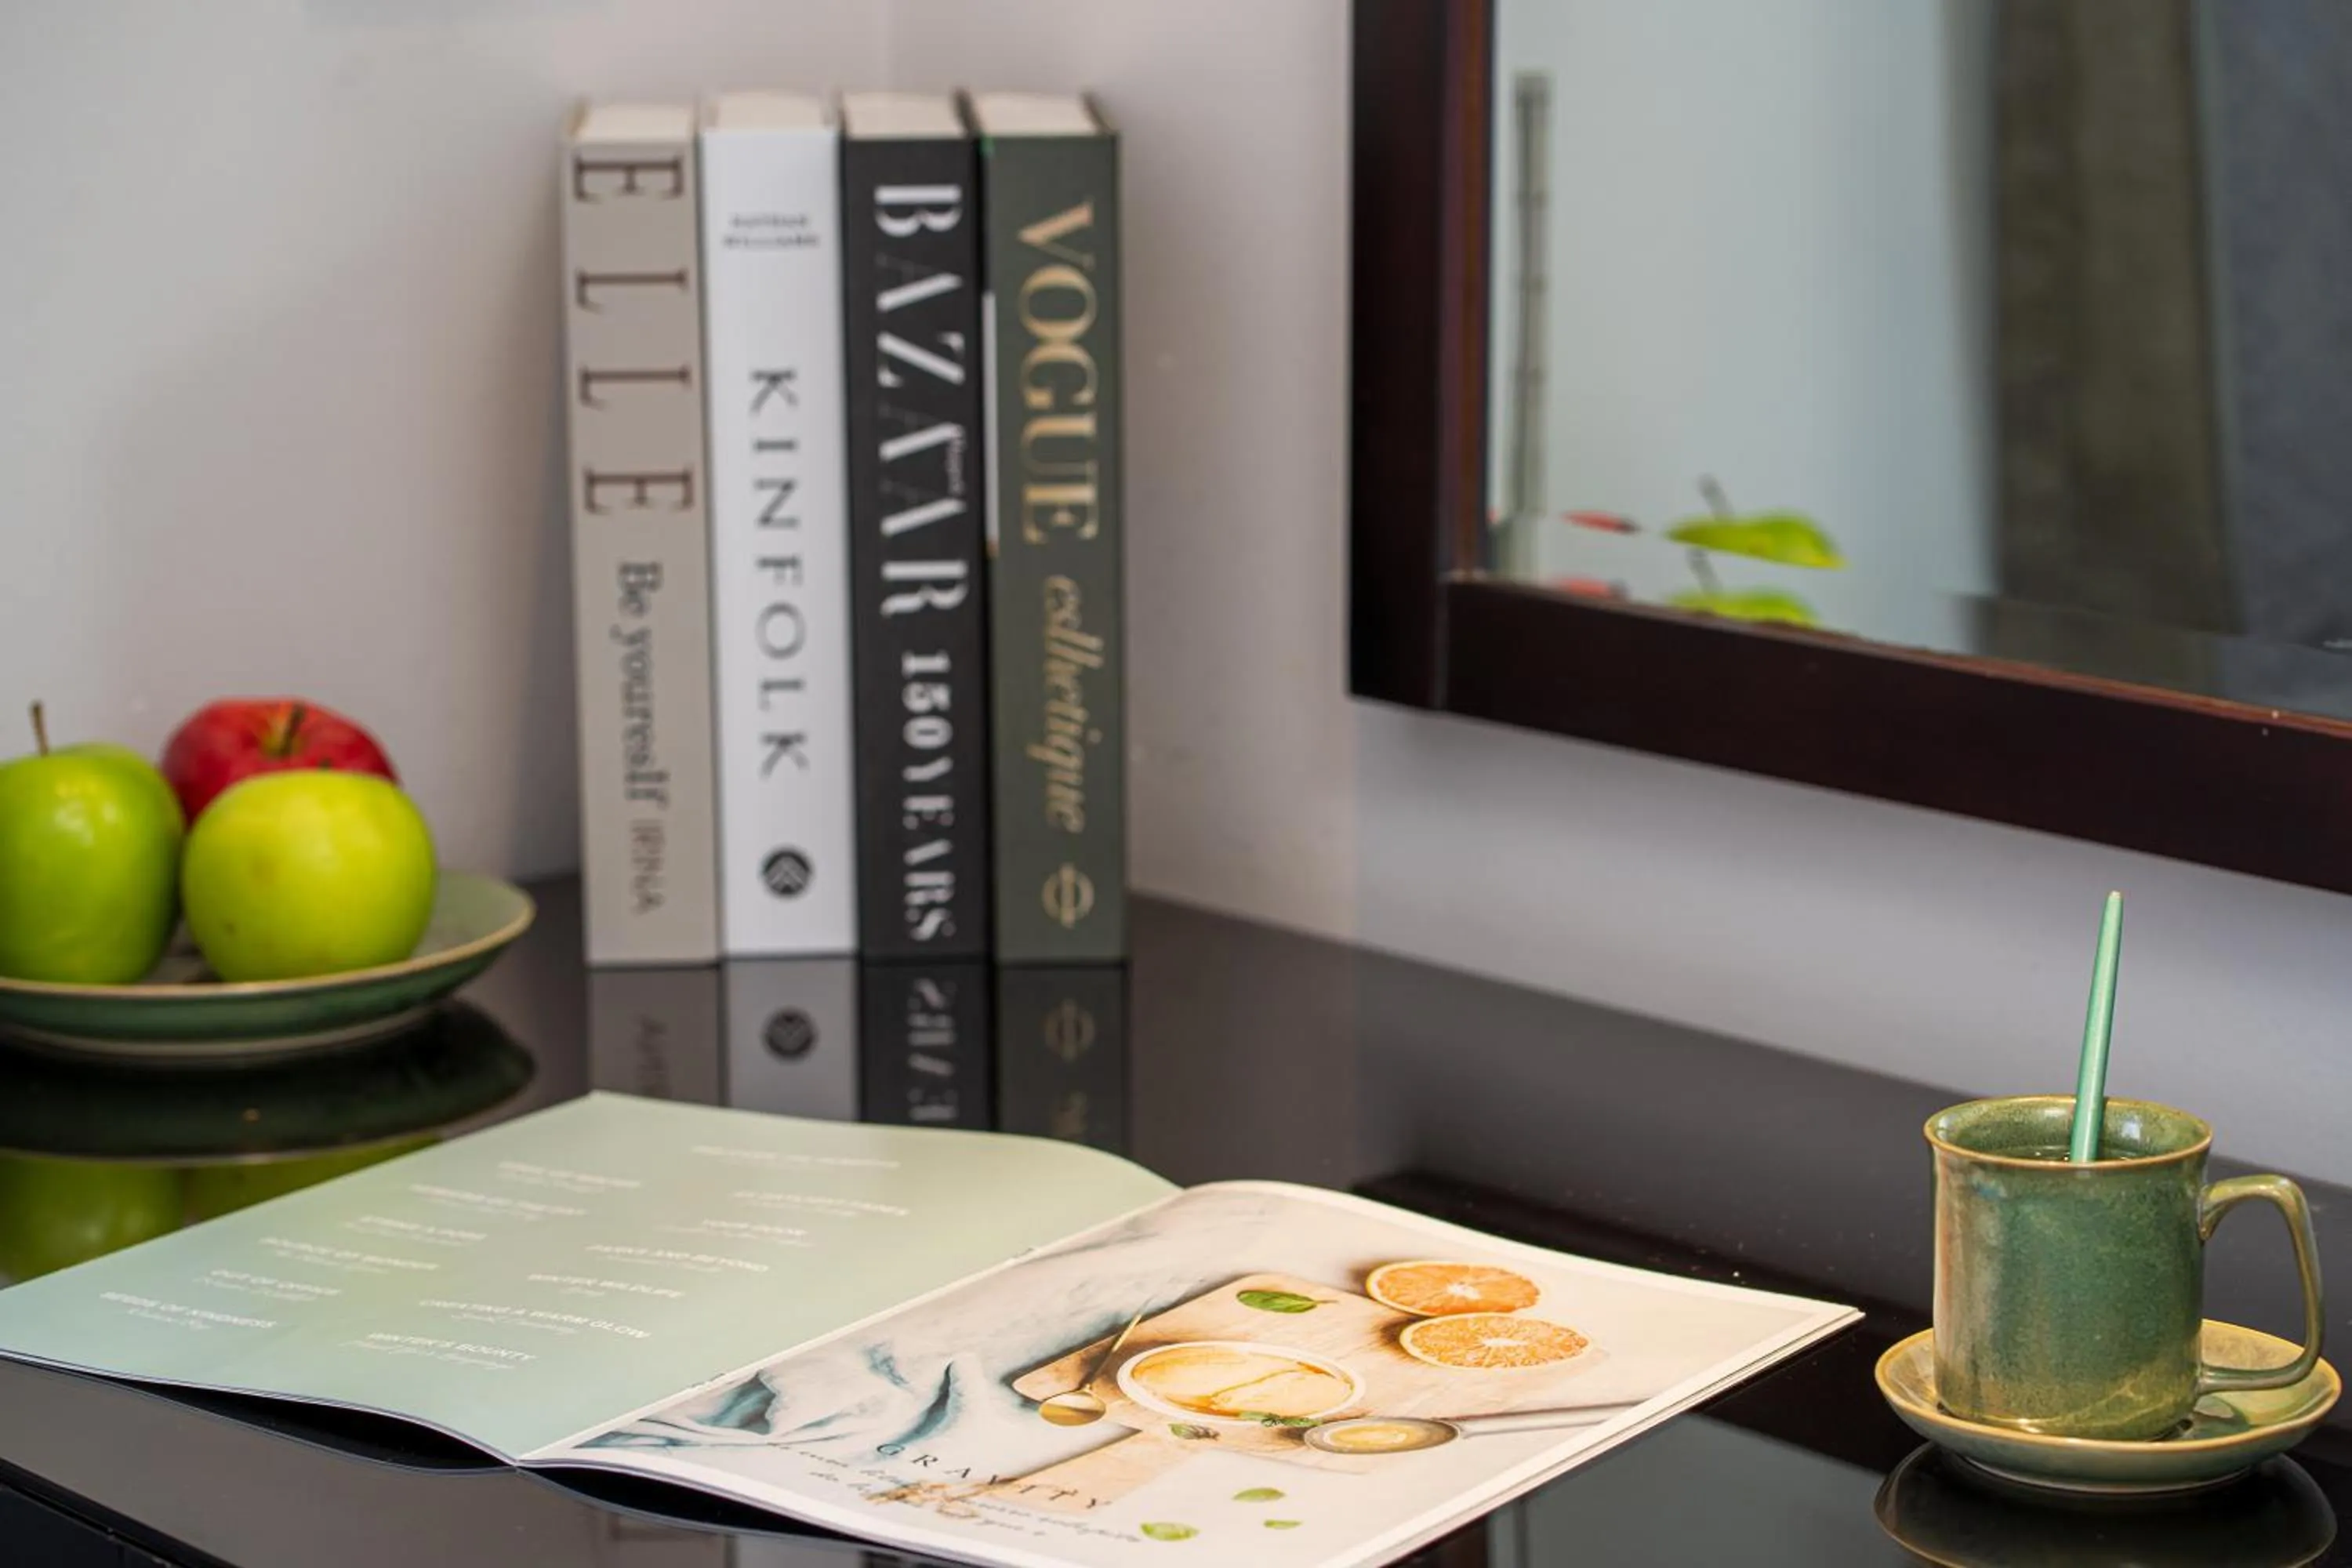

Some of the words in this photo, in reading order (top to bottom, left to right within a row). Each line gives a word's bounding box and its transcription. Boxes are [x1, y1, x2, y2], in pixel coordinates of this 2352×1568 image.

[574, 158, 695, 516] ELLE
[873, 184, 968, 619] BAZAAR
[1019, 201, 1098, 546] VOGUE
[616, 561, 663, 619] Be
[750, 368, 810, 779] KINFOLK
[876, 1443, 1112, 1511] GRAVITY
